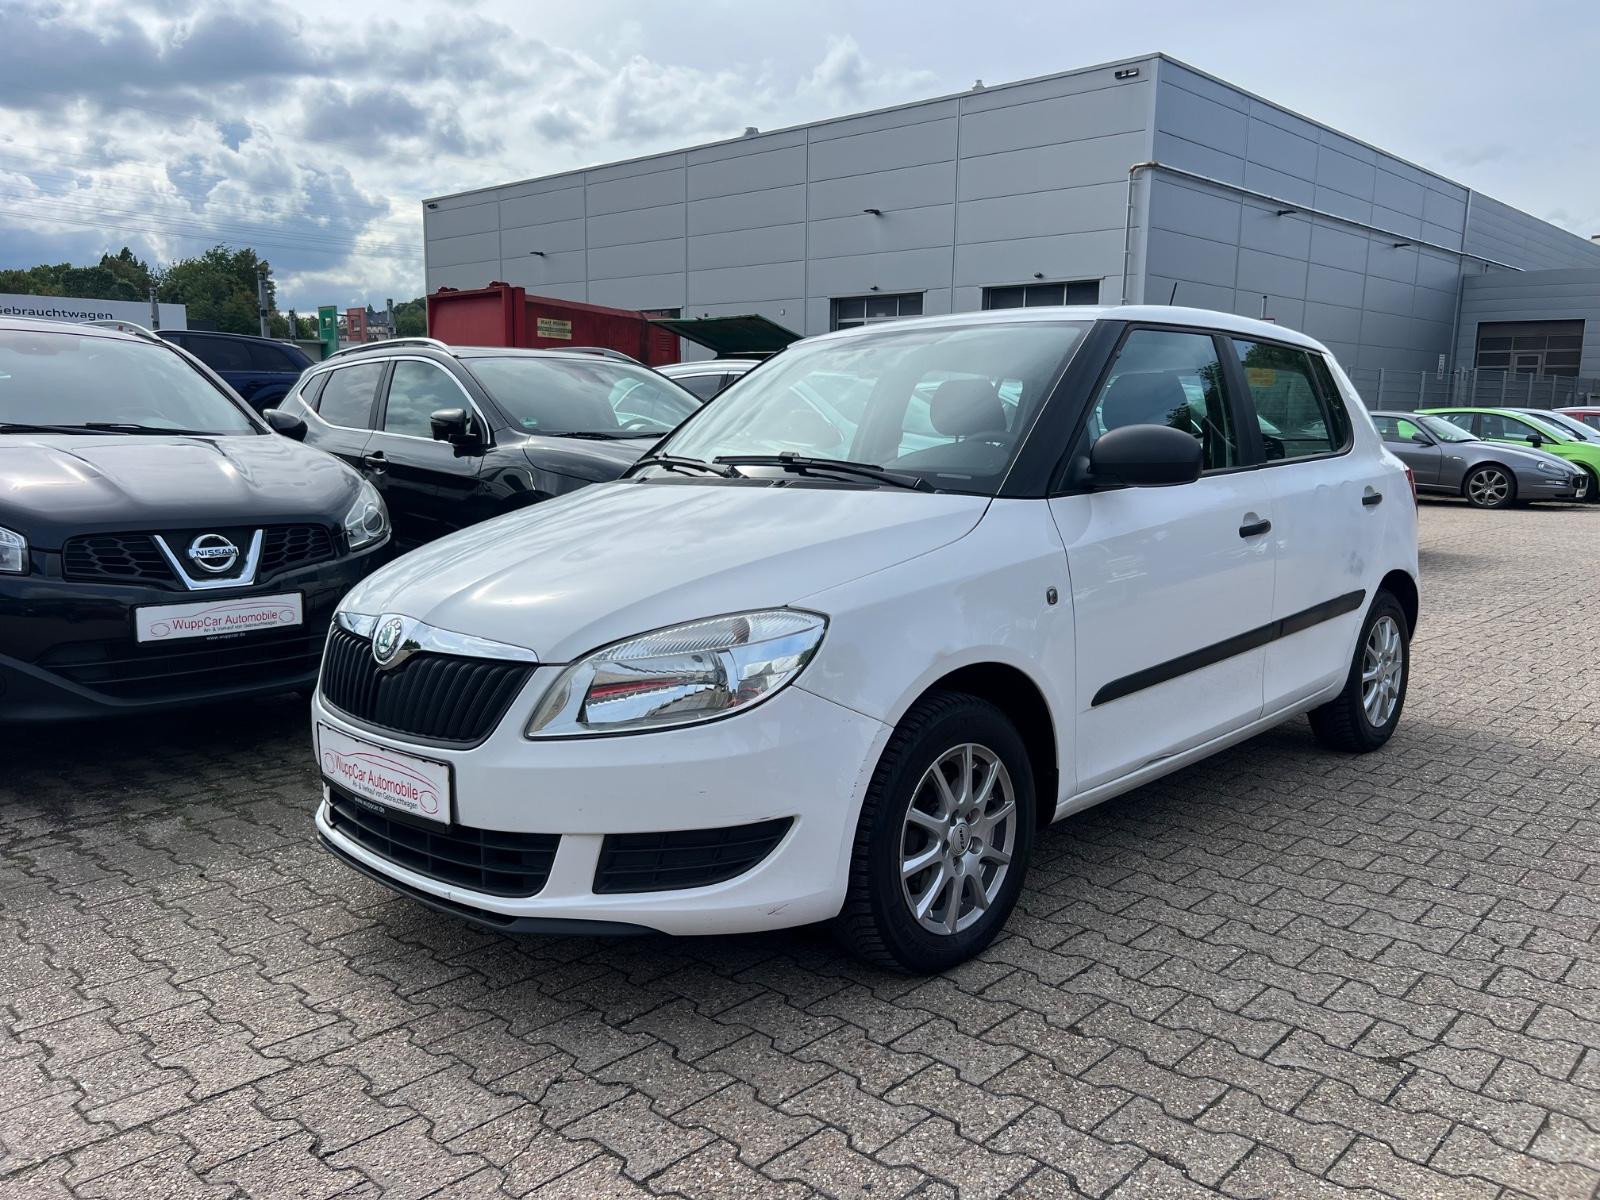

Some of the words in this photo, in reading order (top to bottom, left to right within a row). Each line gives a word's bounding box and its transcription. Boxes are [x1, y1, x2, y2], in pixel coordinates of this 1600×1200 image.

[195, 548, 236, 556] NISSAN
[172, 616, 222, 631] WuppCar
[225, 610, 278, 624] Automobile
[336, 756, 366, 780] WuppCar
[368, 770, 418, 800] Automobile
[382, 792, 418, 810] Gebrauchtwagen
